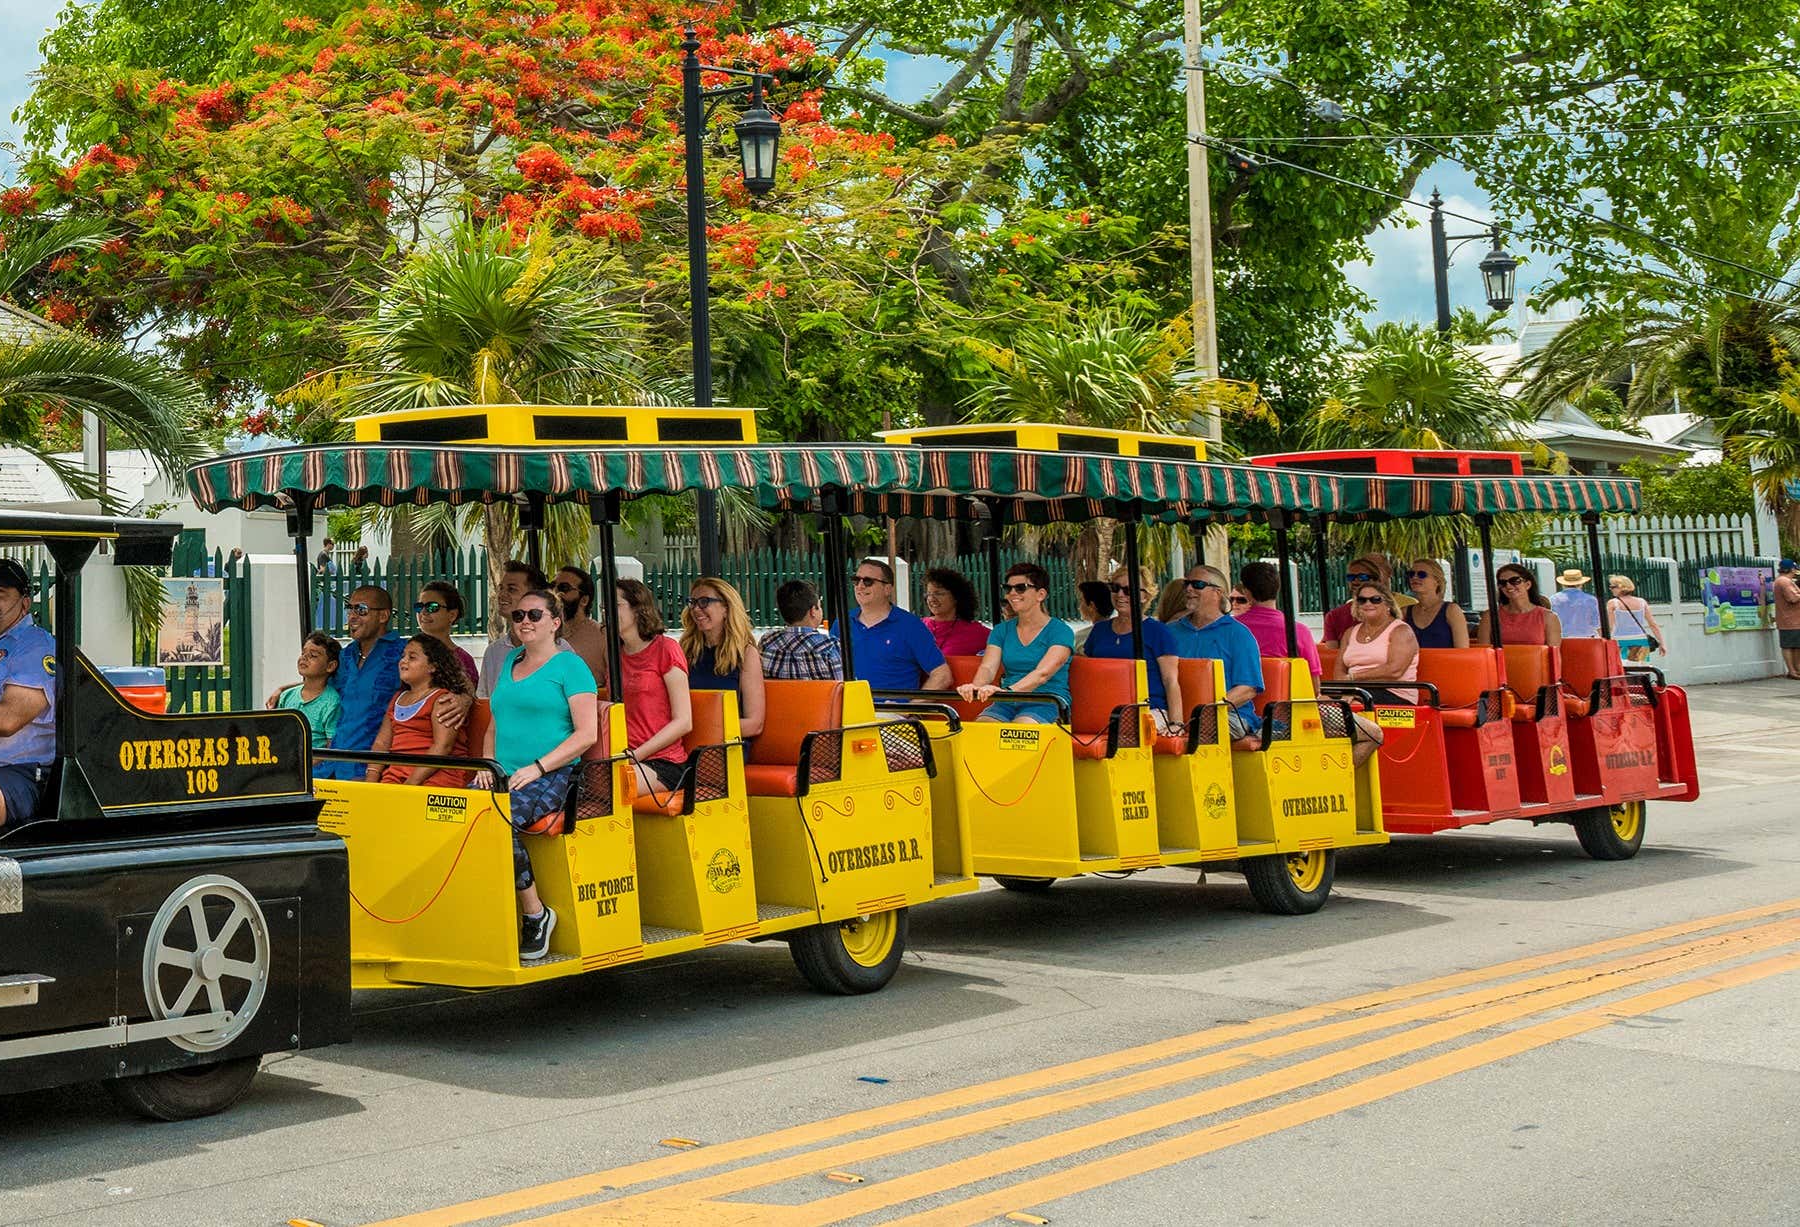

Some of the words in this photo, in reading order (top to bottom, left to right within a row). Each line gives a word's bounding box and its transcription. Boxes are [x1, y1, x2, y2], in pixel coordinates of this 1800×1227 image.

[1379, 709, 1413, 717] CAUTION
[1001, 730, 1038, 739] CAUTION
[119, 737, 229, 771] OVERSEAS
[236, 735, 278, 765] R.R.
[186, 768, 219, 794] 108
[428, 795, 466, 807] CAUTION
[1122, 791, 1146, 805] STOCK
[1283, 796, 1329, 817] OVERSEAS
[1122, 806, 1149, 820] ISLAND
[828, 842, 895, 874] OVERSEAS
[897, 837, 923, 862] R.R.
[577, 883, 596, 902] BIG
[599, 875, 635, 898] TORCH
[597, 898, 618, 917] KEY
